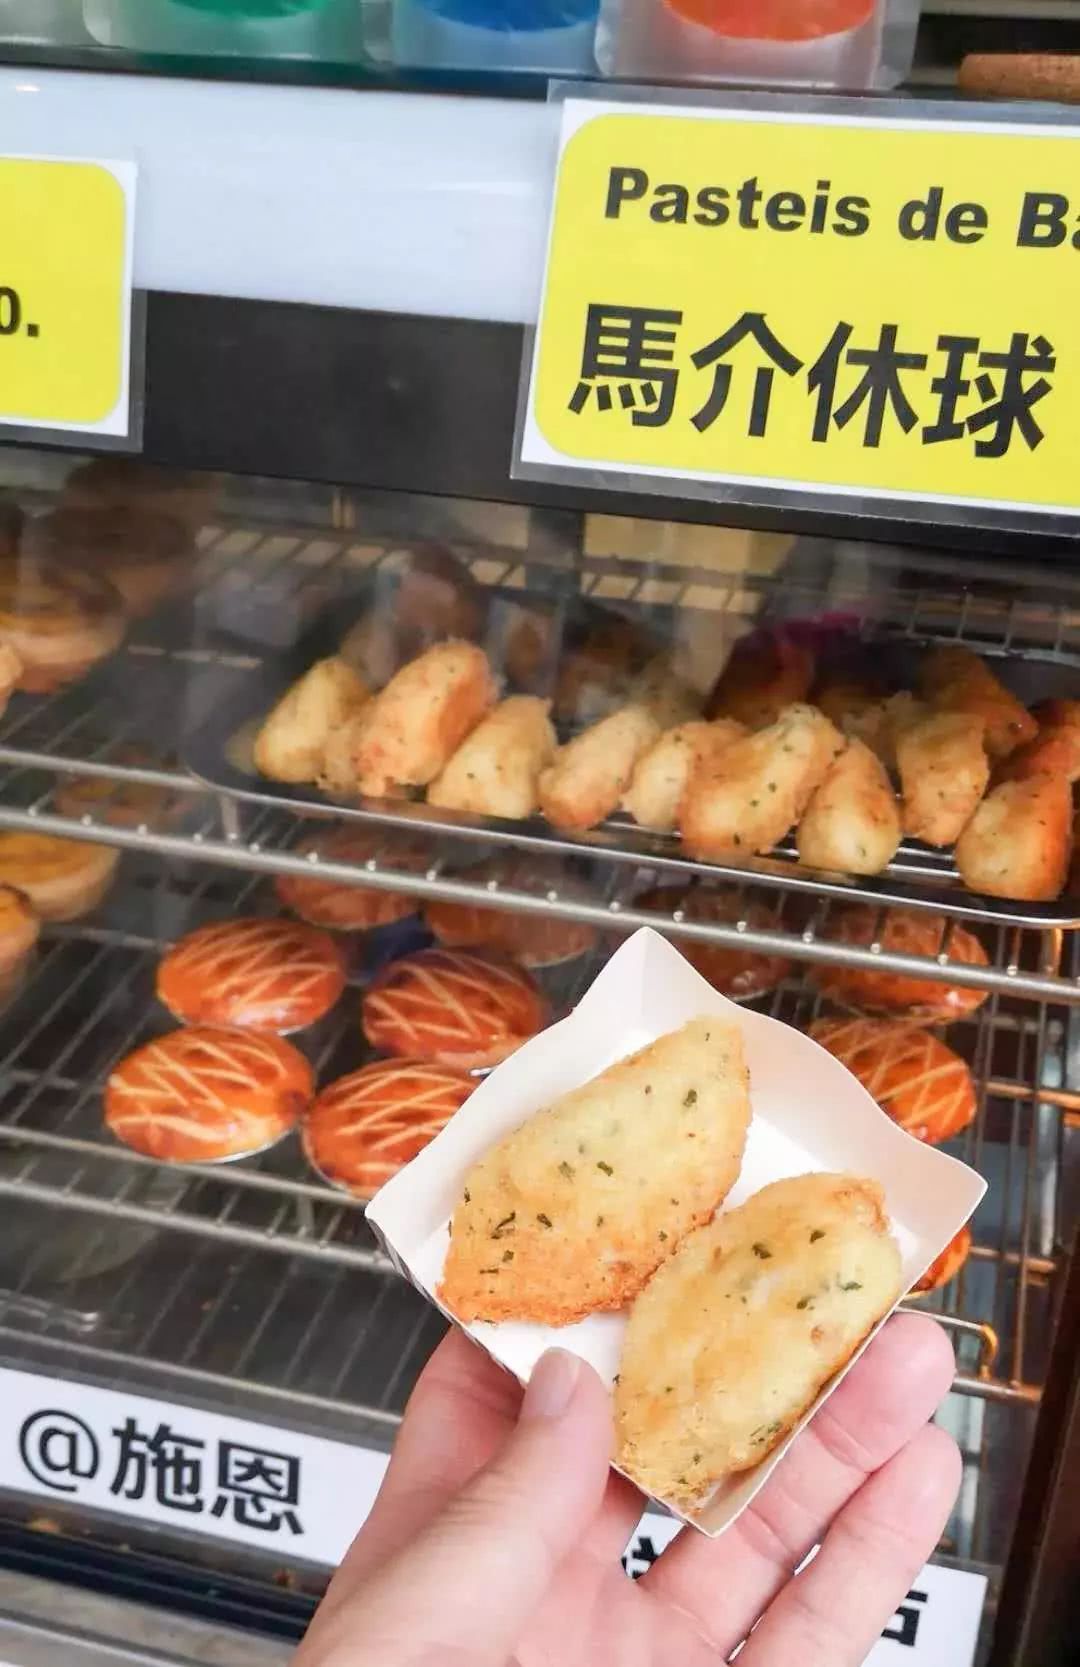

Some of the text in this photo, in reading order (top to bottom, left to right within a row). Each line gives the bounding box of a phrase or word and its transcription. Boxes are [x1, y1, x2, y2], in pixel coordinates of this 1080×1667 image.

[604, 166, 871, 237] Pasteis
[898, 186, 989, 244] de
[567, 303, 1057, 458] 馬介休球
